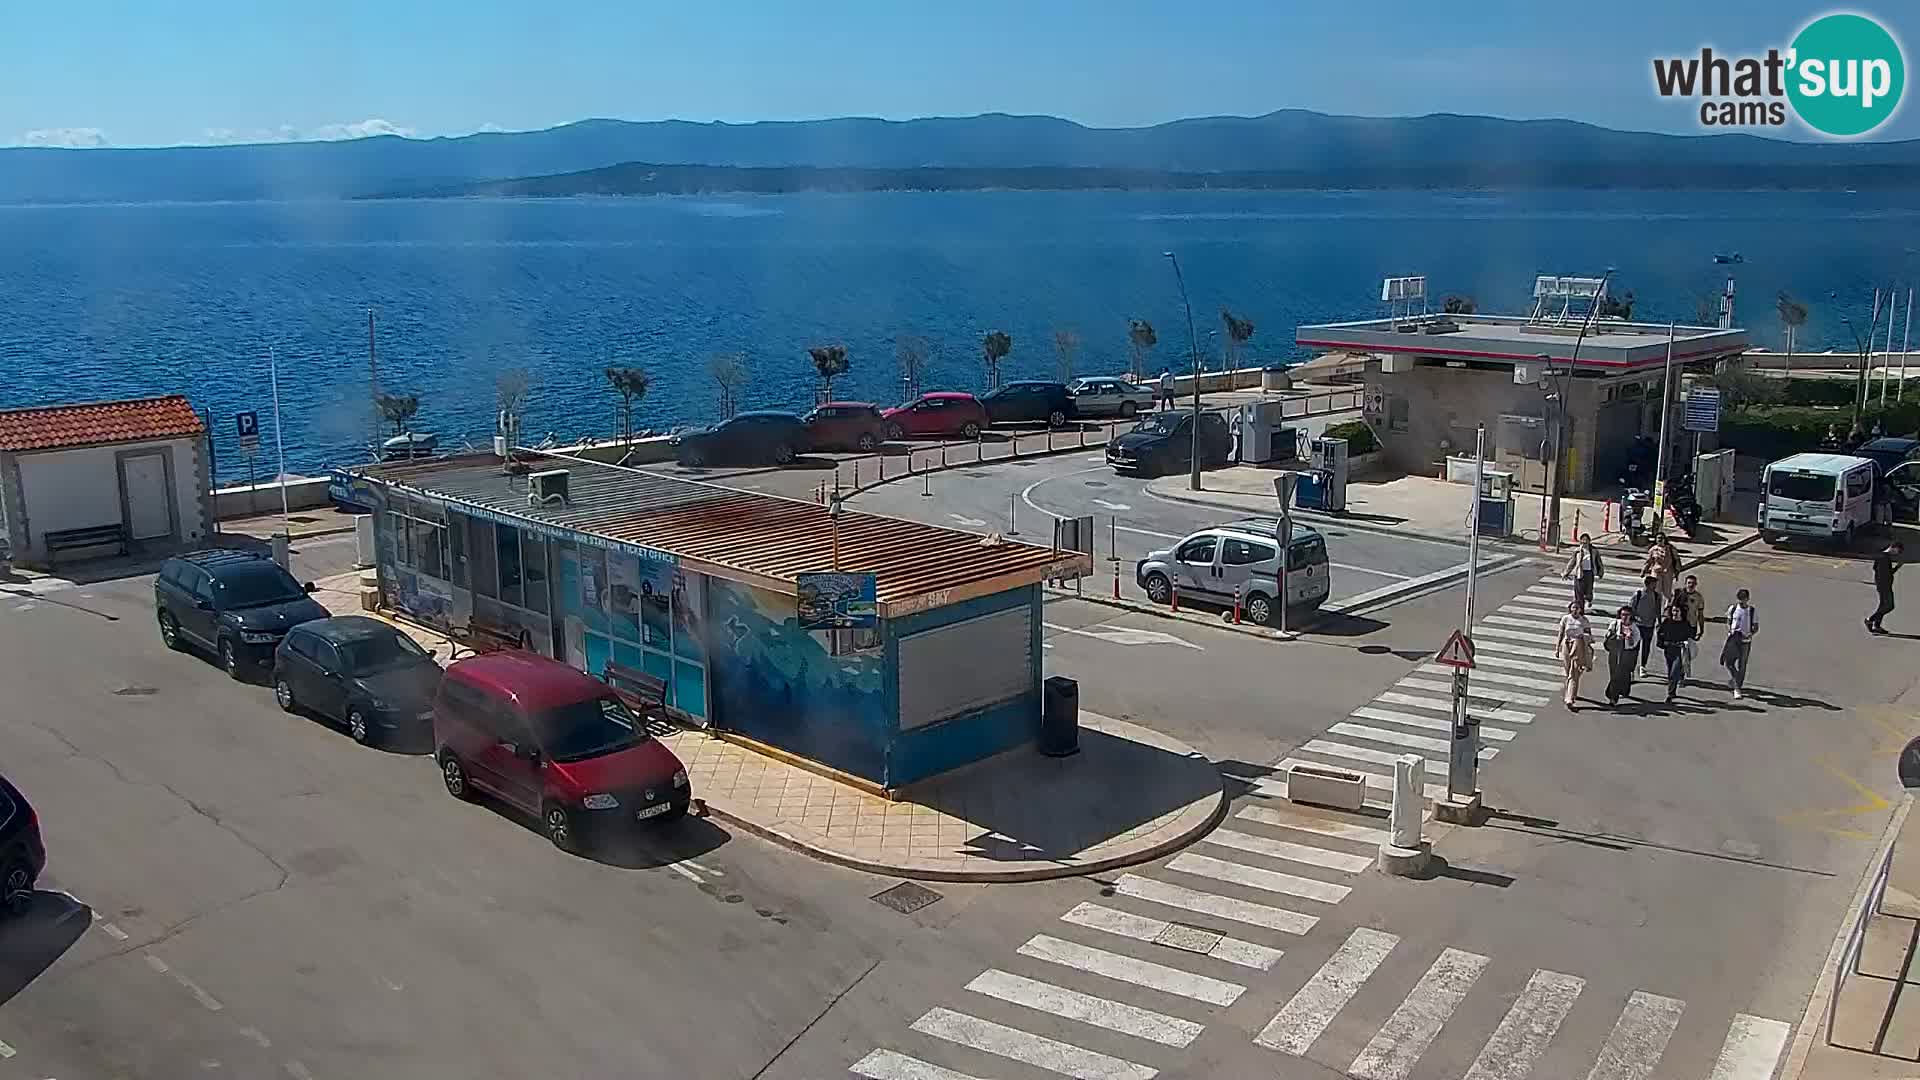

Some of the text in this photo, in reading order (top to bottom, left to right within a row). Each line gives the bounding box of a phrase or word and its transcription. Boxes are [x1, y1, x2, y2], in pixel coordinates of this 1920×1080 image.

[589, 536, 621, 552] STATION
[623, 544, 649, 559] TICKET
[648, 549, 676, 564] OFFICE
